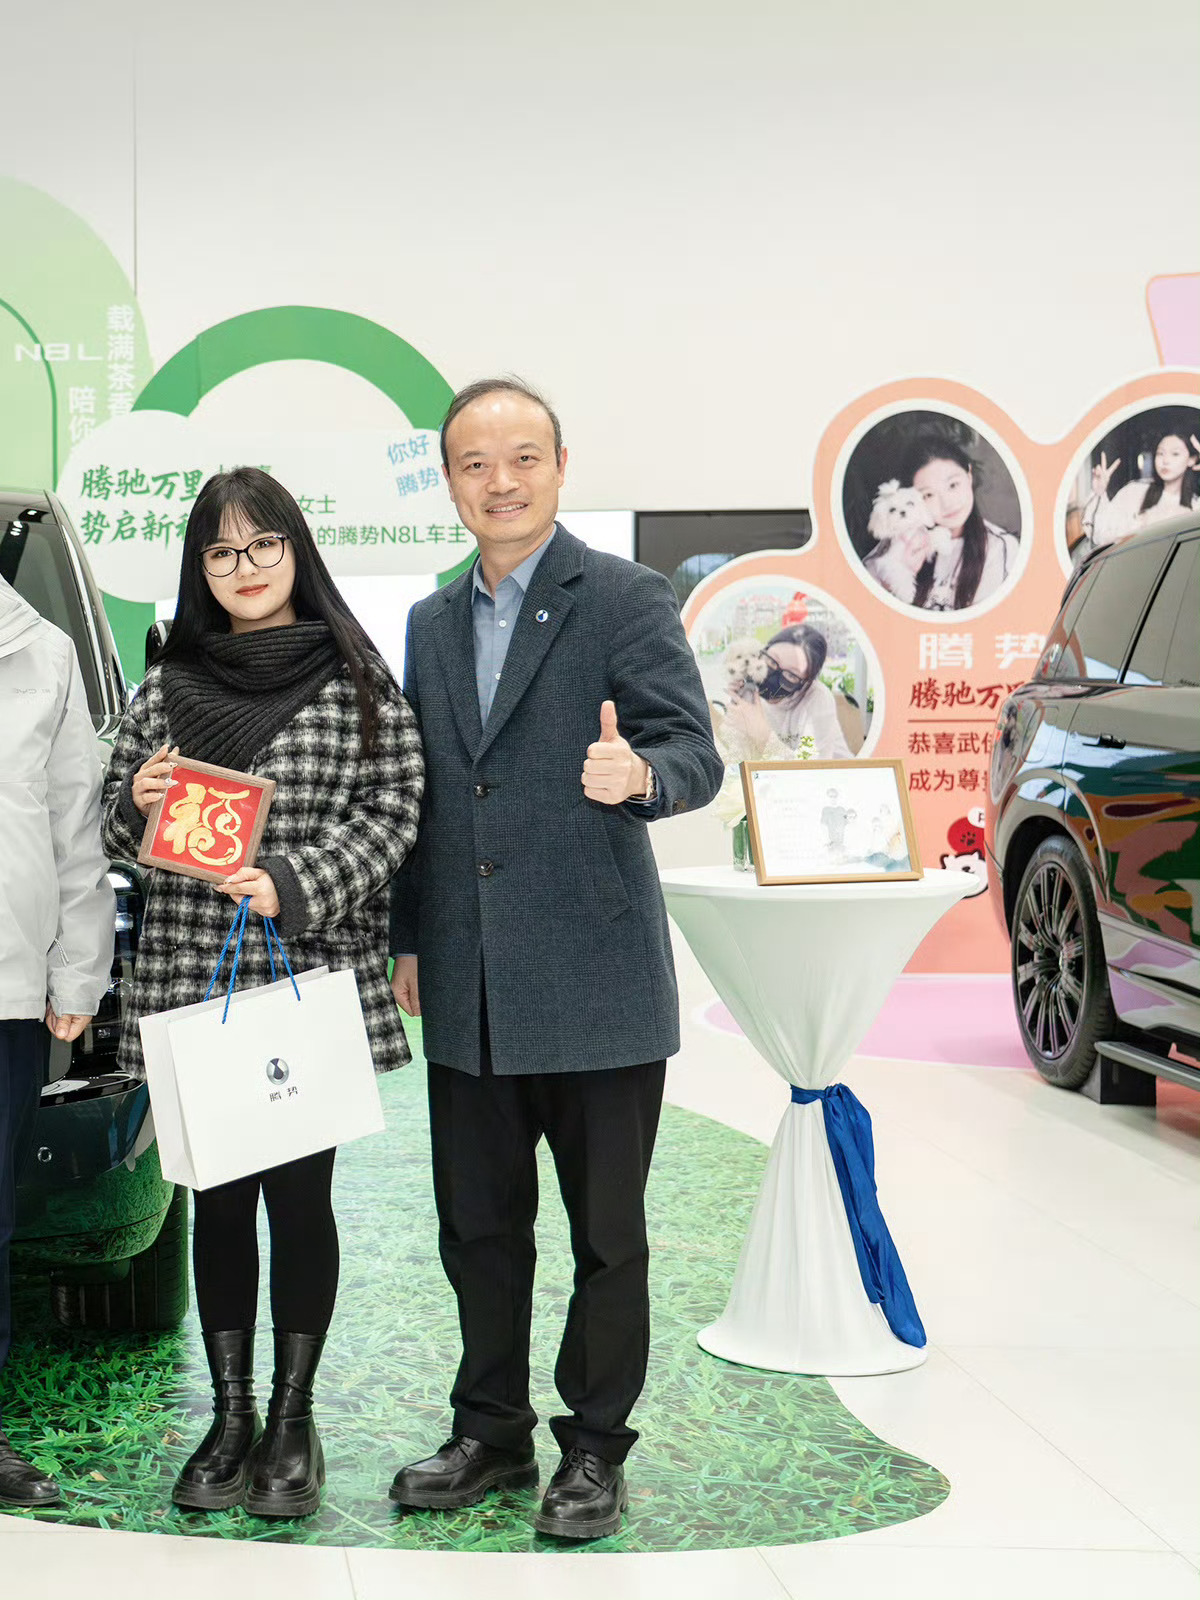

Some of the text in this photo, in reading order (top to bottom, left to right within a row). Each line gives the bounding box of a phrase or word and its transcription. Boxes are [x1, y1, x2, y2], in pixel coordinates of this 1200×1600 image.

[15, 343, 103, 362] N8L
[387, 434, 430, 465] 你好
[80, 464, 204, 502] 腾驰万里
[396, 467, 440, 497] 腾势
[297, 494, 336, 514] 女士
[311, 524, 468, 546] 的腾势N8L车主
